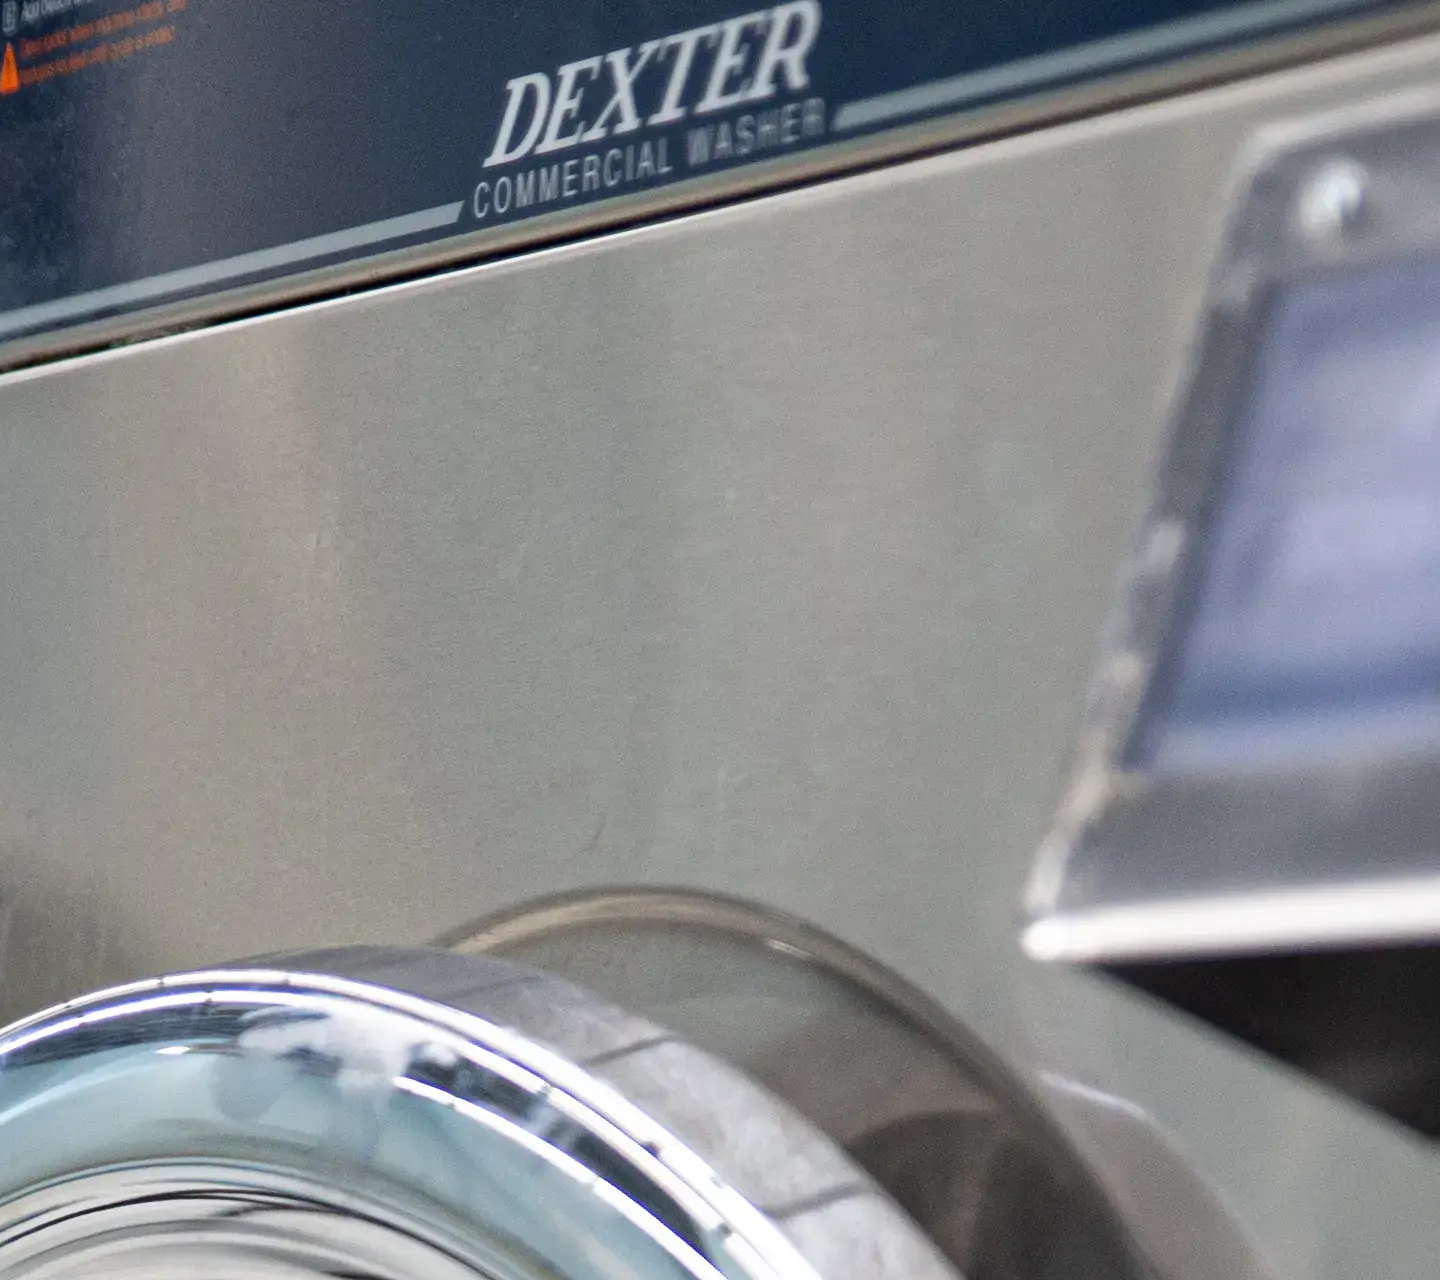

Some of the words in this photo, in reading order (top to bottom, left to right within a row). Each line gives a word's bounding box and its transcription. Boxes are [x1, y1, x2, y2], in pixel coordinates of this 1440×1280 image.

[482, 0, 822, 168] DEXTER
[473, 137, 675, 220] COMMERCIAL
[686, 97, 826, 167] WASHER
